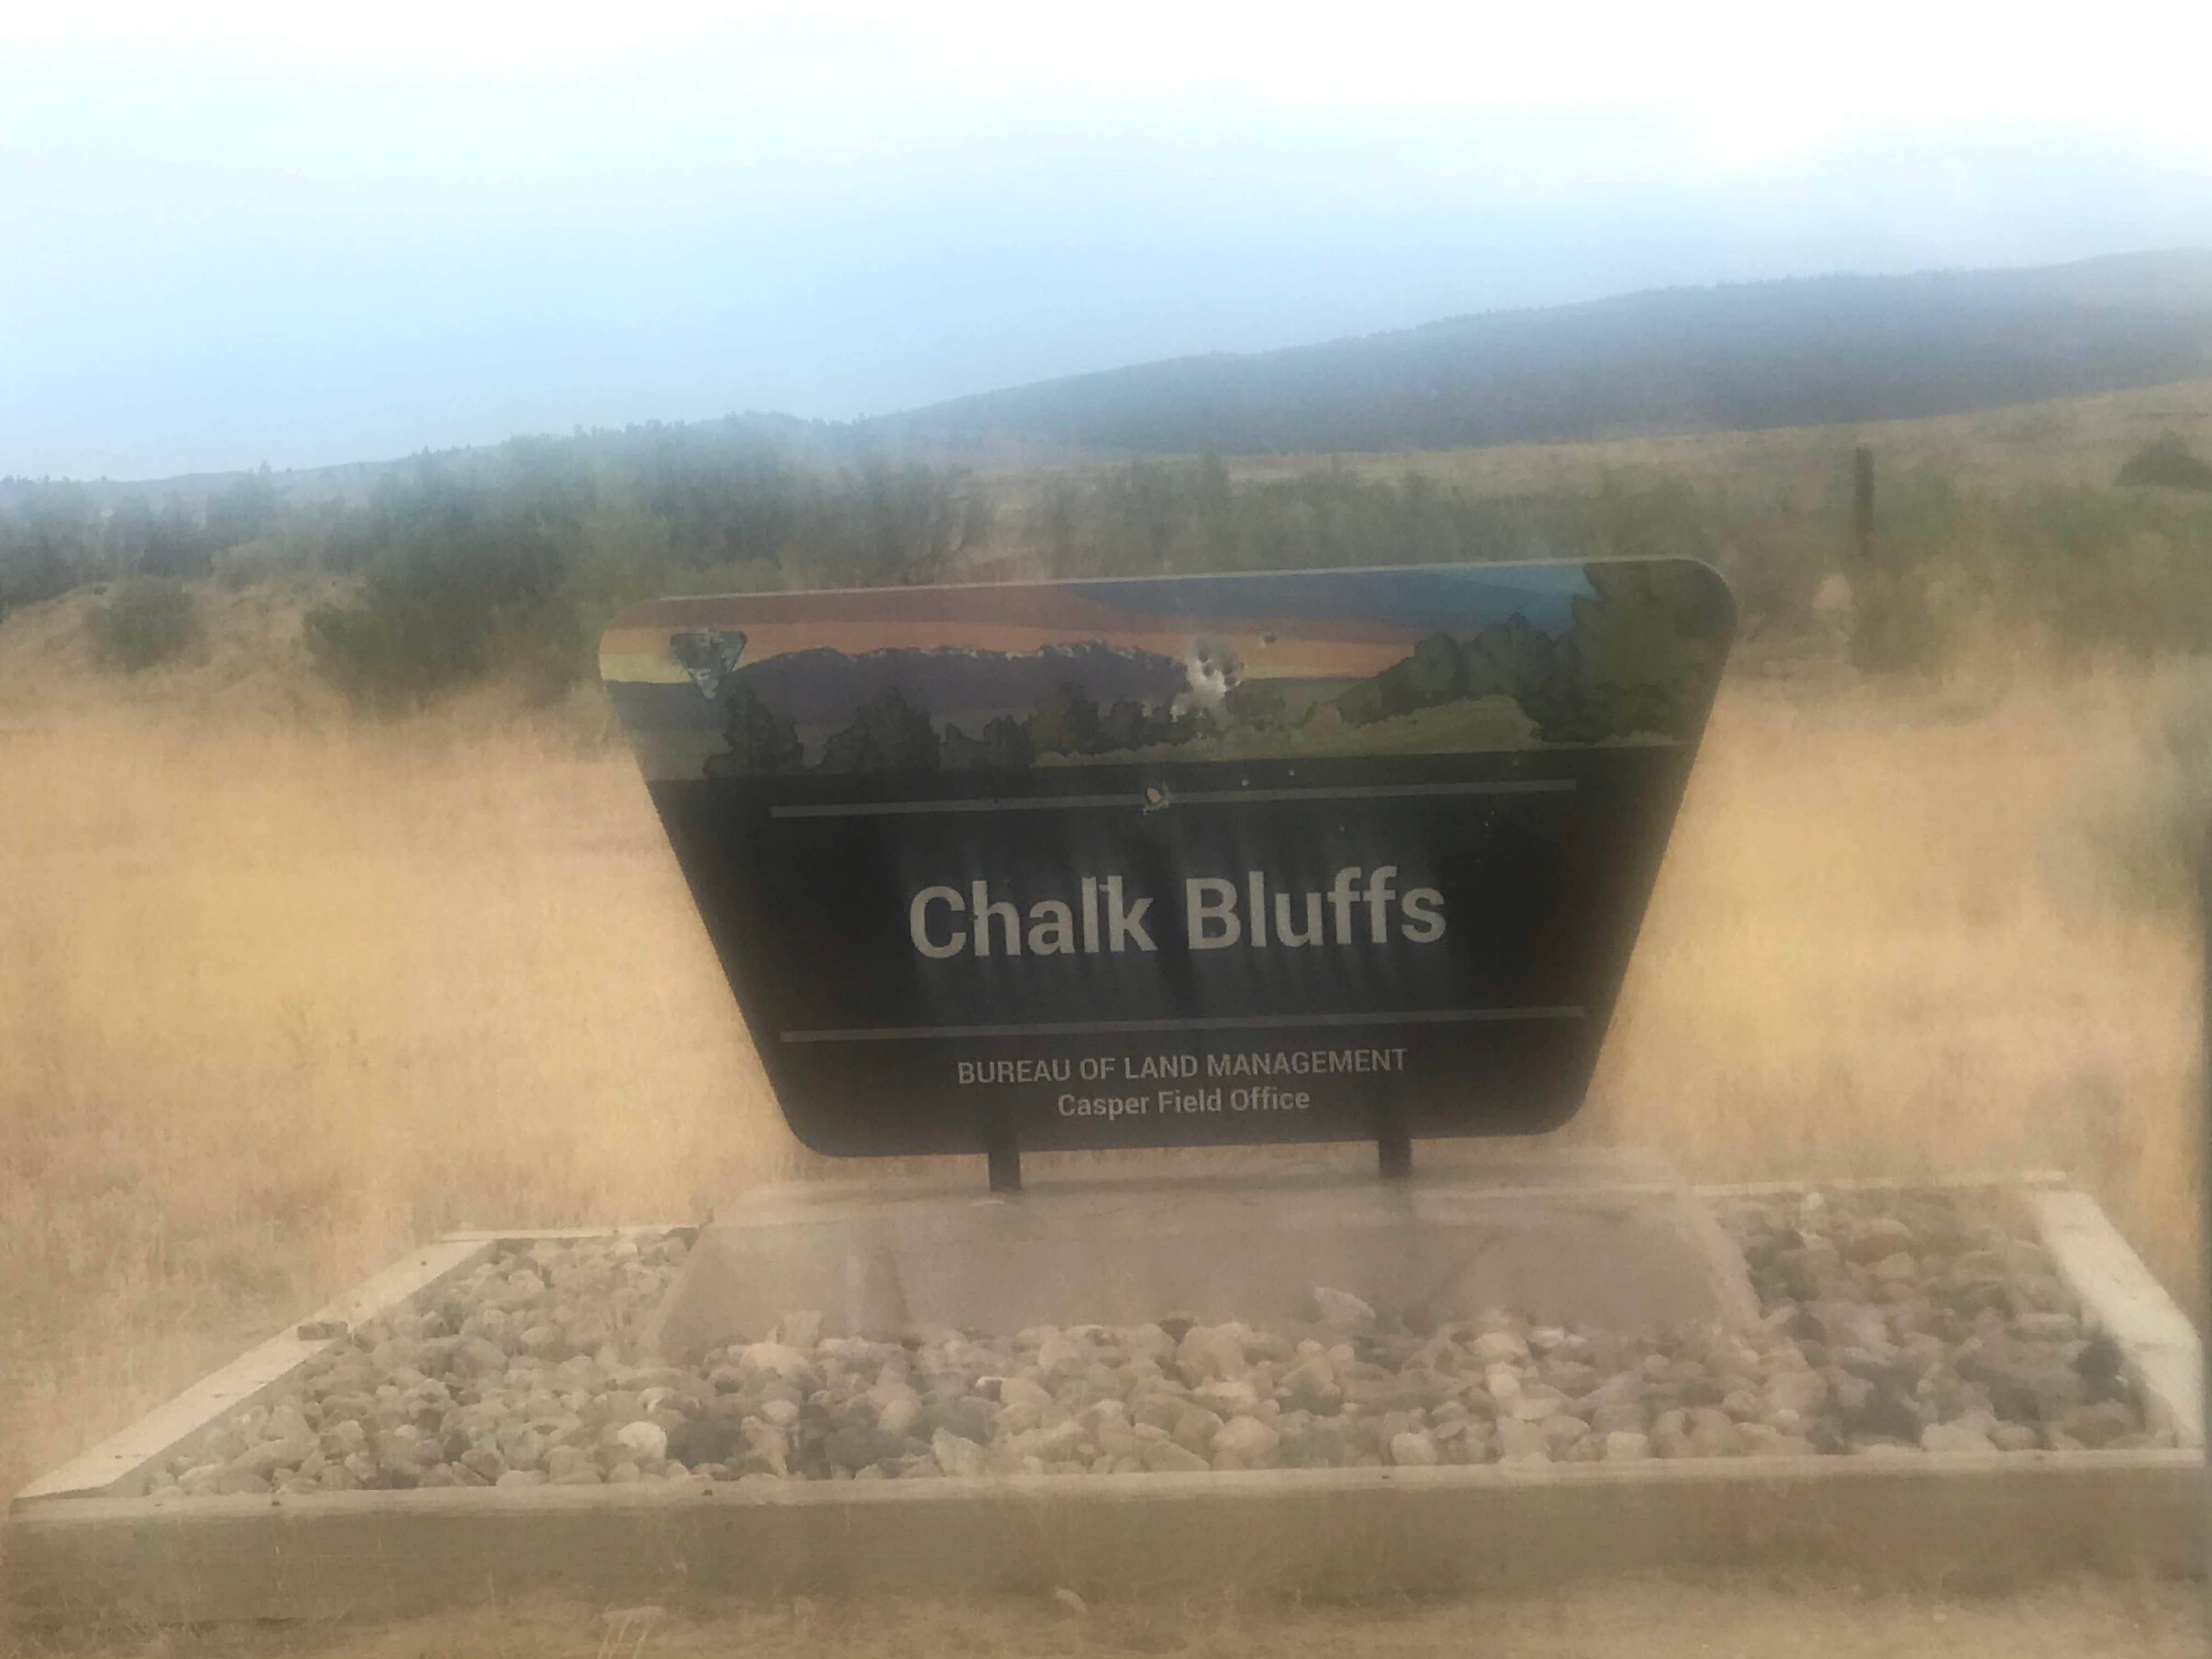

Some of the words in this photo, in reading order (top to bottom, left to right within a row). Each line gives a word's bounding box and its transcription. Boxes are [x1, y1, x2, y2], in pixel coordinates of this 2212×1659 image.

[909, 874, 1159, 960] Chalk
[1184, 865, 1447, 951] Bluffs
[957, 1058, 1071, 1085] BUREAU
[1079, 1057, 1117, 1081] OF
[1124, 1054, 1199, 1080] LAND
[1207, 1048, 1408, 1077] MANAGEMENT
[1058, 1093, 1150, 1121] Casper
[1158, 1087, 1222, 1114] Field
[1230, 1086, 1310, 1112] Office
